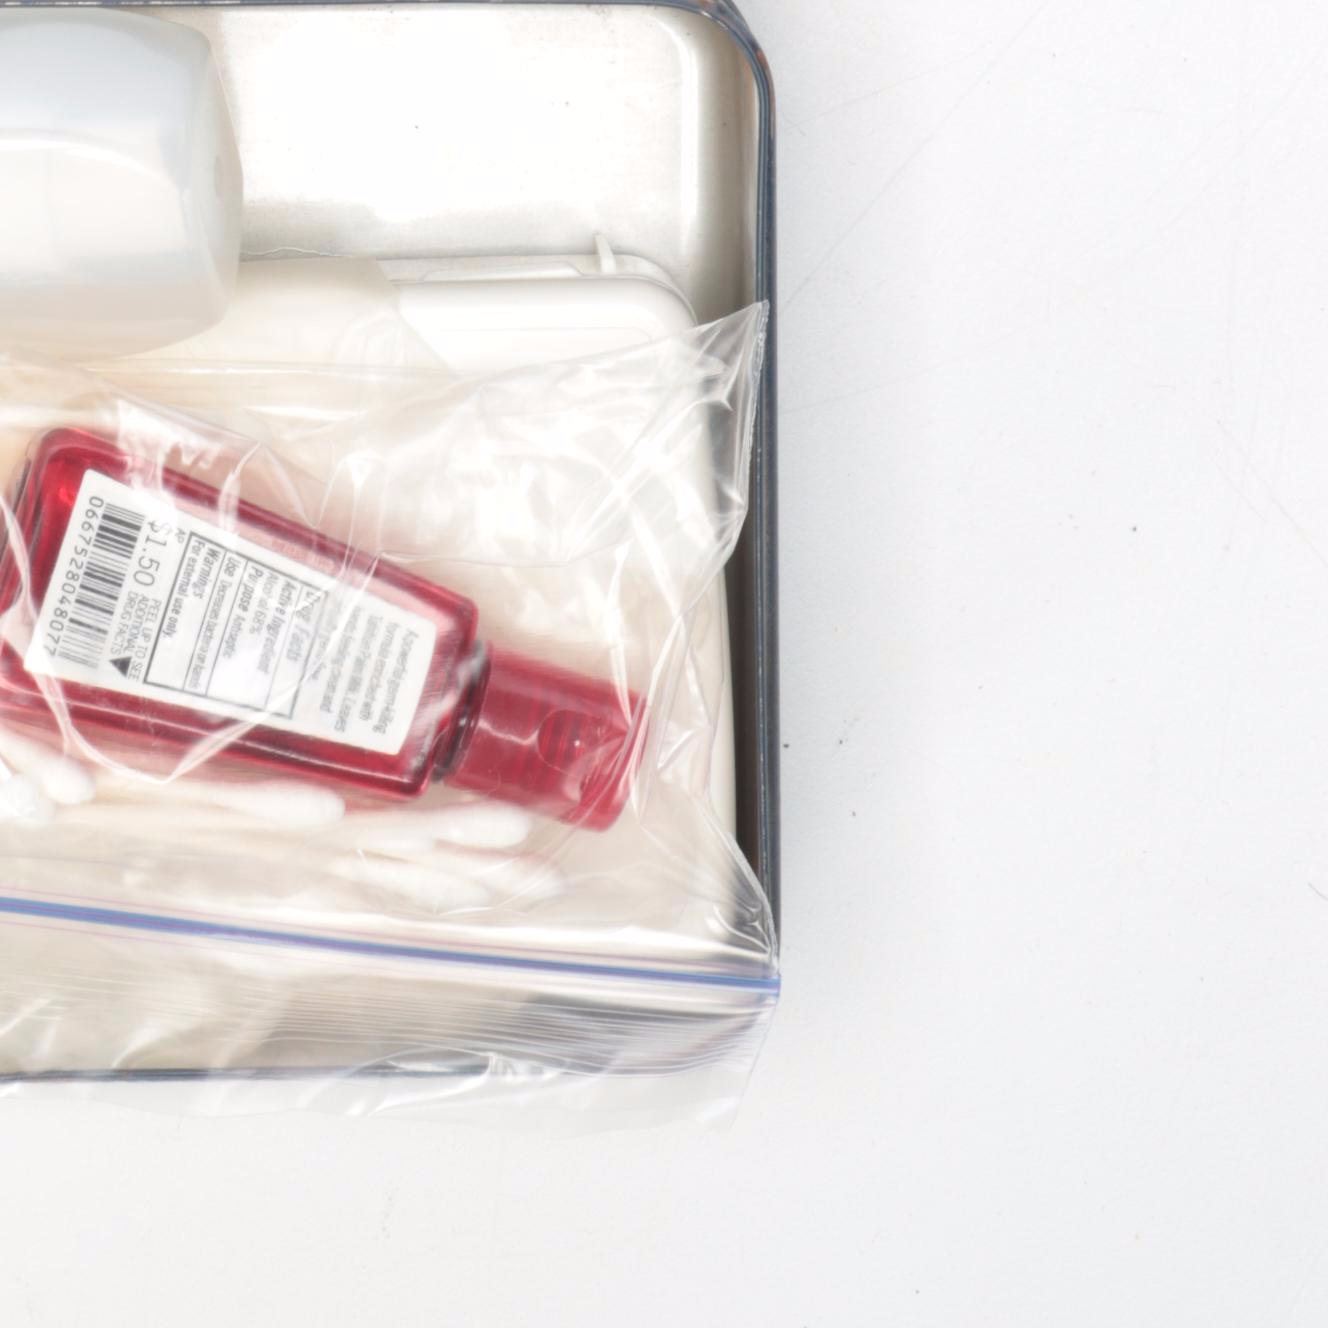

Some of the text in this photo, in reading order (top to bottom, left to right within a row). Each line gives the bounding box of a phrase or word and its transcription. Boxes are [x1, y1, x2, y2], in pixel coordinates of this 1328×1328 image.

[43, 495, 105, 657] 0667528048077
[178, 556, 198, 598] external
[110, 590, 139, 656] DRUG FACTS
[122, 593, 150, 653] ADDITIONAL
[146, 598, 162, 626] PEEL
